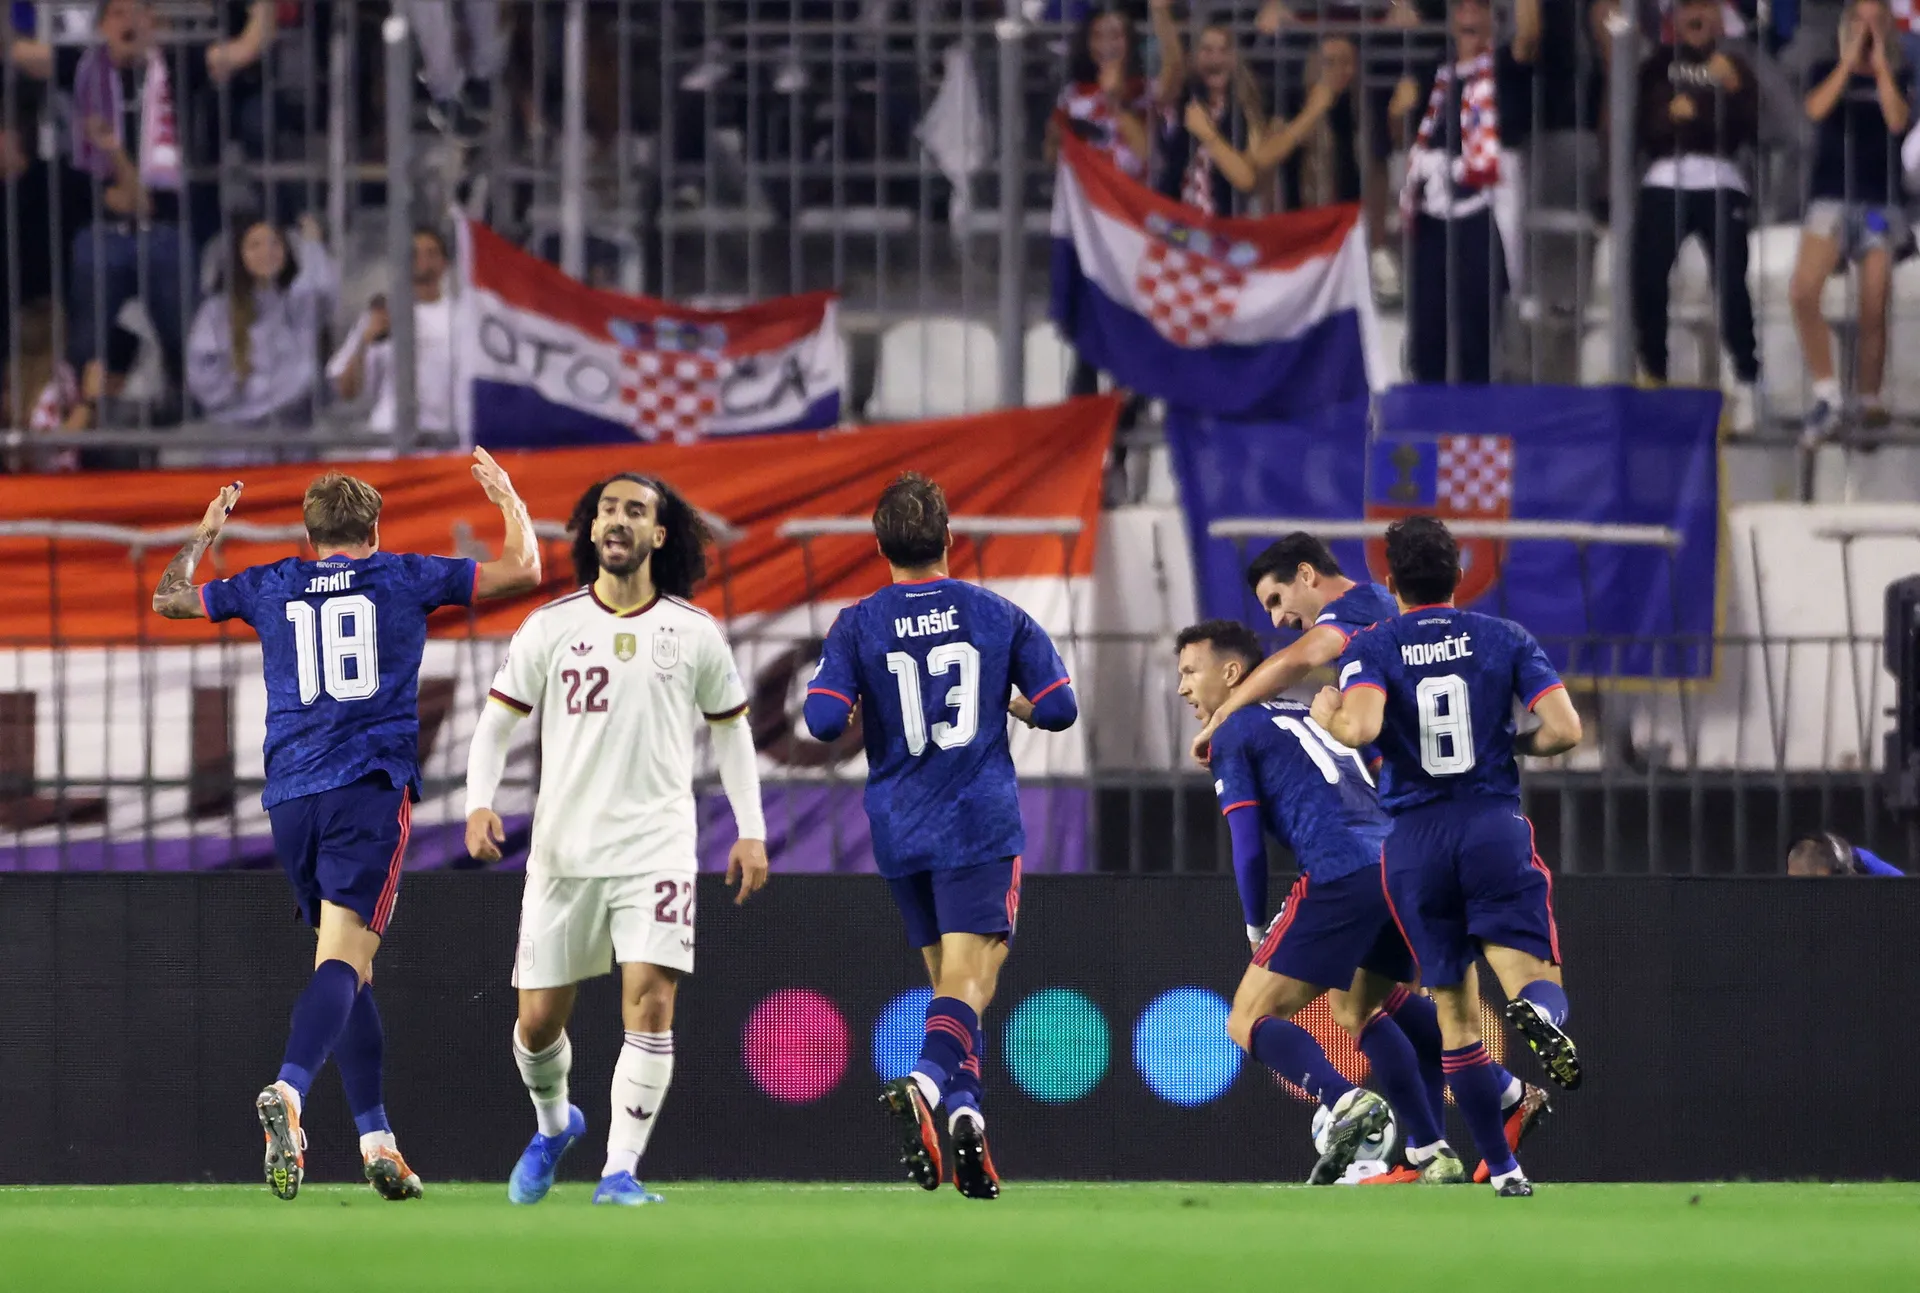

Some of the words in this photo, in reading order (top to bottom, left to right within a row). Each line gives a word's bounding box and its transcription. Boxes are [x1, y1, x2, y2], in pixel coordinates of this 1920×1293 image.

[286, 594, 380, 705] 18
[894, 604, 960, 638] VLAŠIĆ
[1400, 631, 1473, 666] KOVAČIĆ
[561, 665, 609, 715] 22
[886, 641, 981, 757] 13
[1416, 673, 1476, 778] 8
